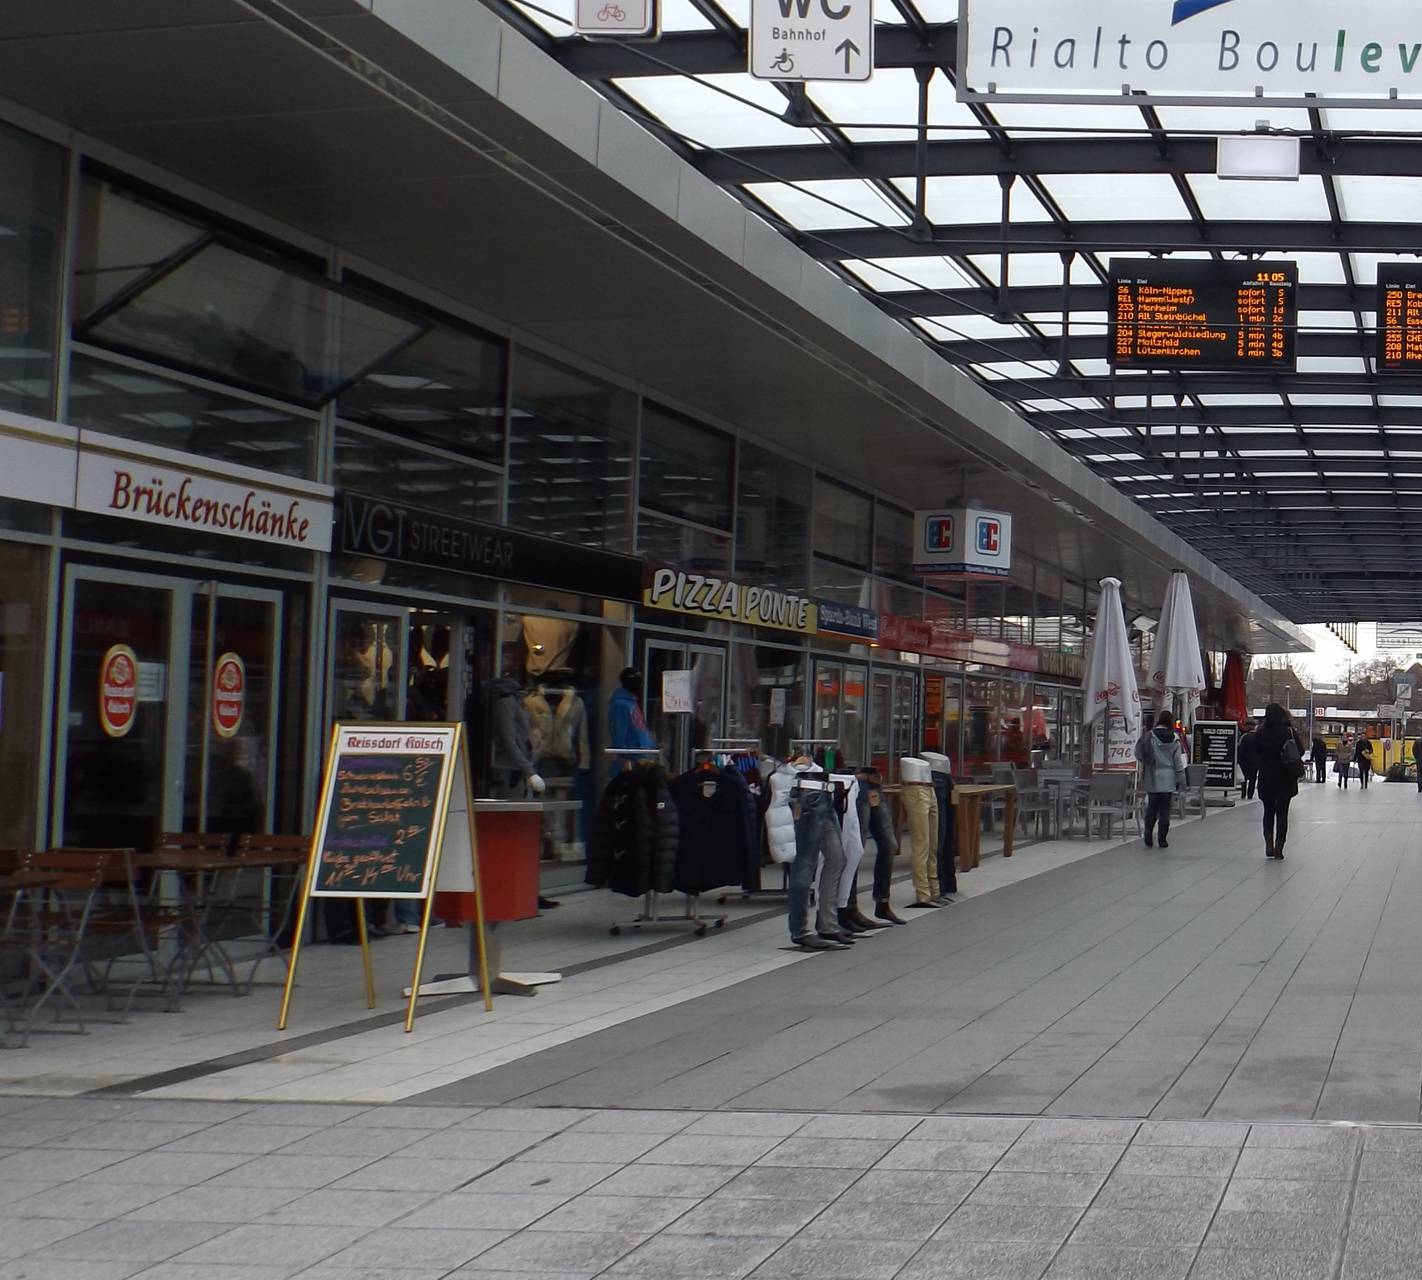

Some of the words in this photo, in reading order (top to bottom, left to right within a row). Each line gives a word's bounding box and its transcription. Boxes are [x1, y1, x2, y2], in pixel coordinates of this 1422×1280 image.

[772, 27, 826, 41] Bahnhof
[990, 26, 1170, 72] Rialto
[1139, 287, 1192, 295] Köln-Nippes
[1238, 306, 1265, 314] sofort
[1138, 330, 1226, 339] Stegerwaldsiedlung
[1137, 347, 1200, 355] Lützenkirchen
[110, 470, 309, 542] Brückenschänke
[411, 521, 513, 568] STREETWEAR
[652, 568, 740, 619] PIZZA
[744, 586, 810, 630] PONTE
[347, 736, 400, 749] Reissdorf
[405, 736, 444, 751] Kölsch
